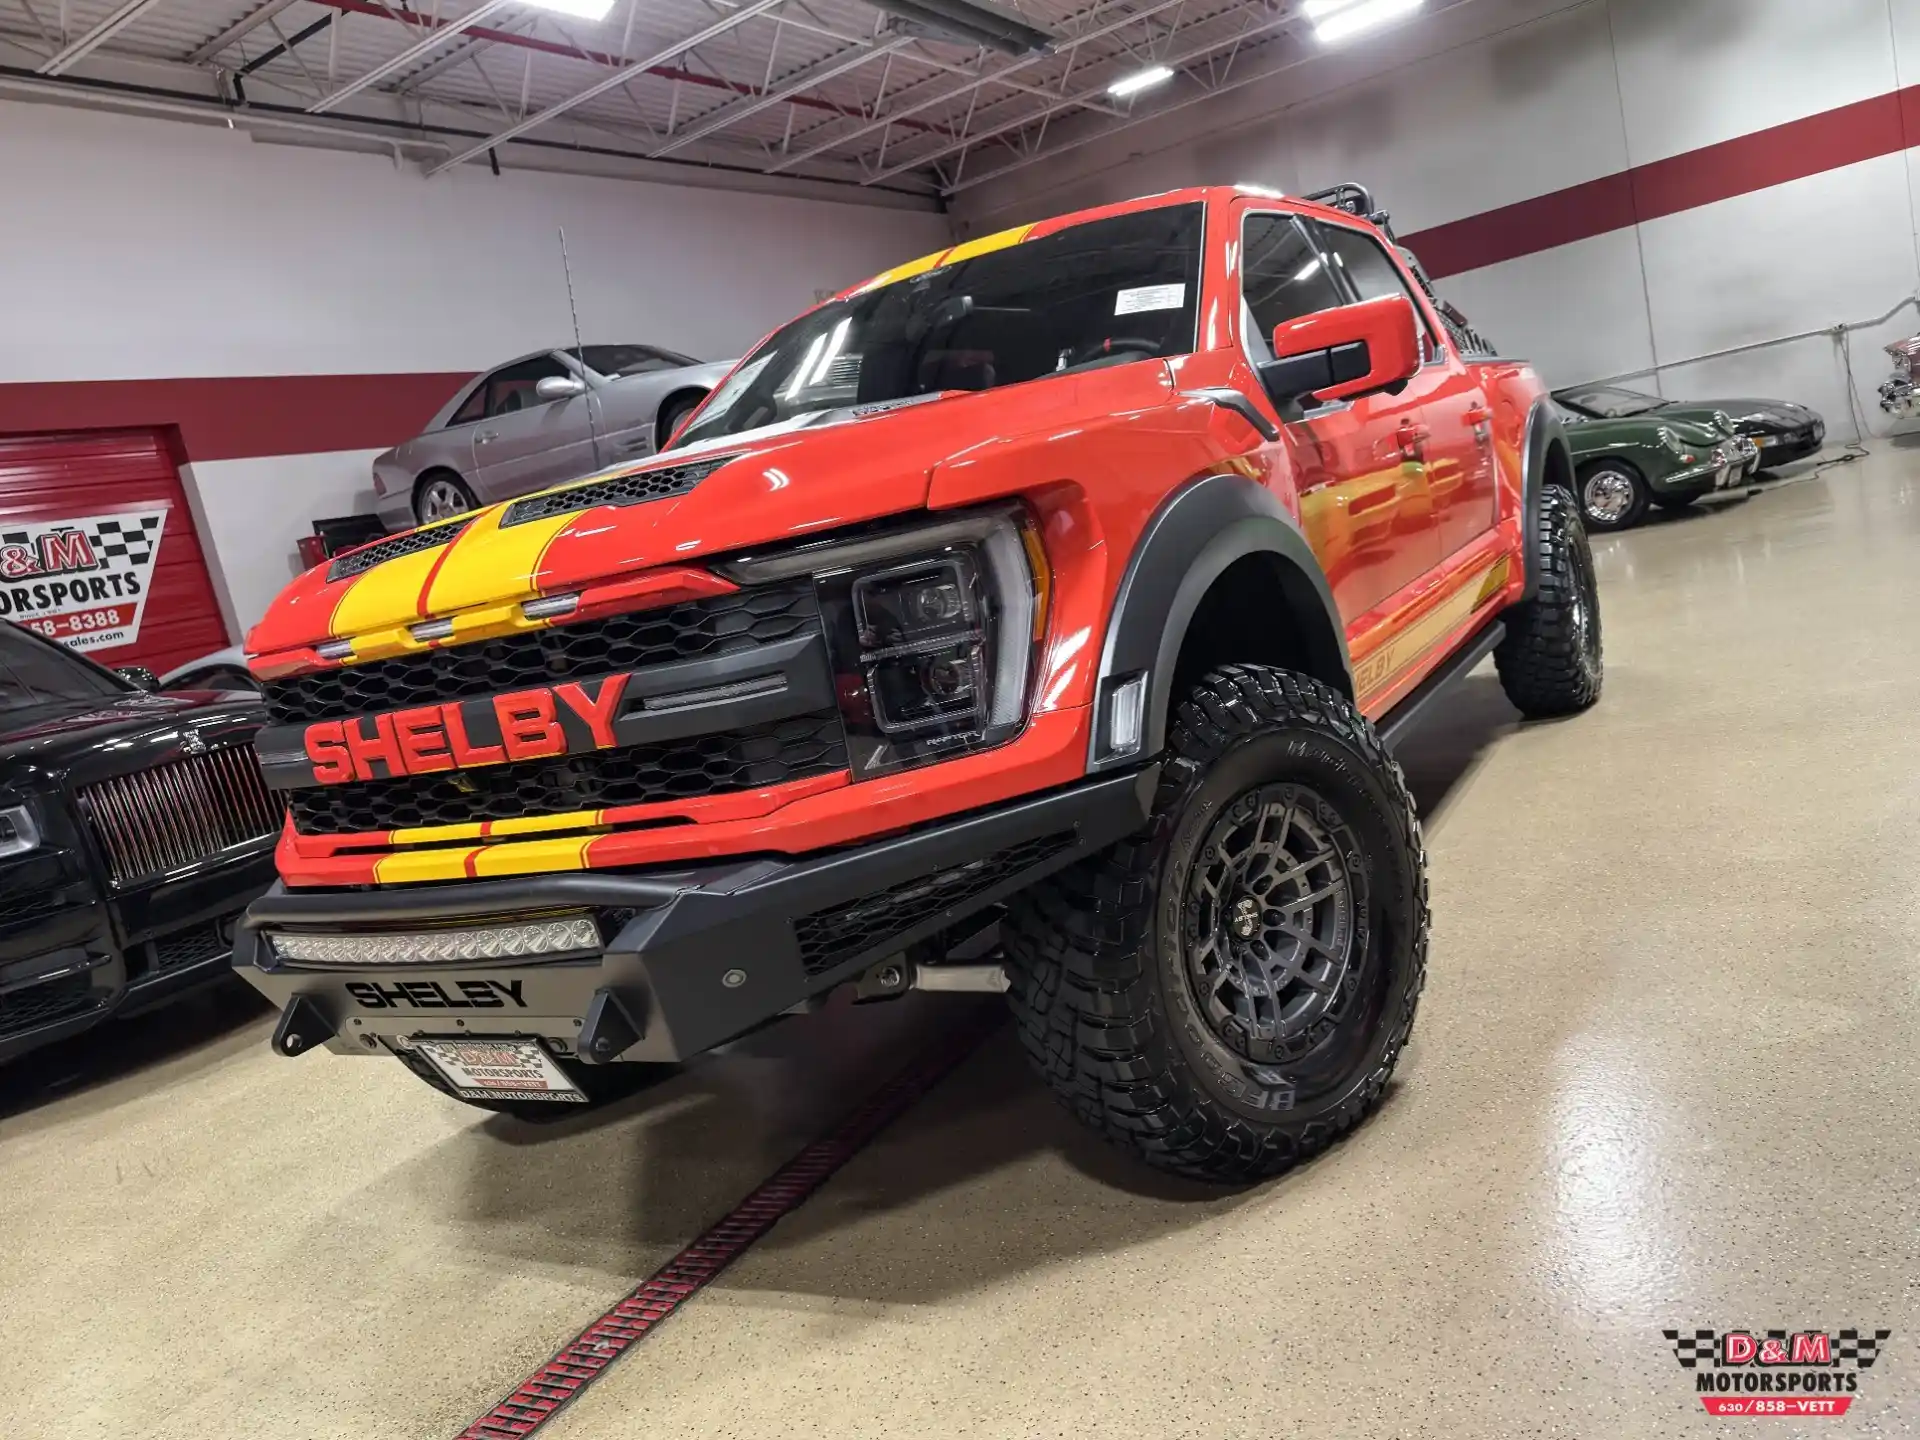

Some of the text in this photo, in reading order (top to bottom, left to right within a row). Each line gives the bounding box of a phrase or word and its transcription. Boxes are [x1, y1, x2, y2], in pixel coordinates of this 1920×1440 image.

[304, 673, 632, 785] SHELBY
[345, 980, 528, 1008] SHELBY
[461, 1067, 545, 1079] MOTORSPORTS
[459, 1090, 584, 1102] D&M MOTORSPORTS
